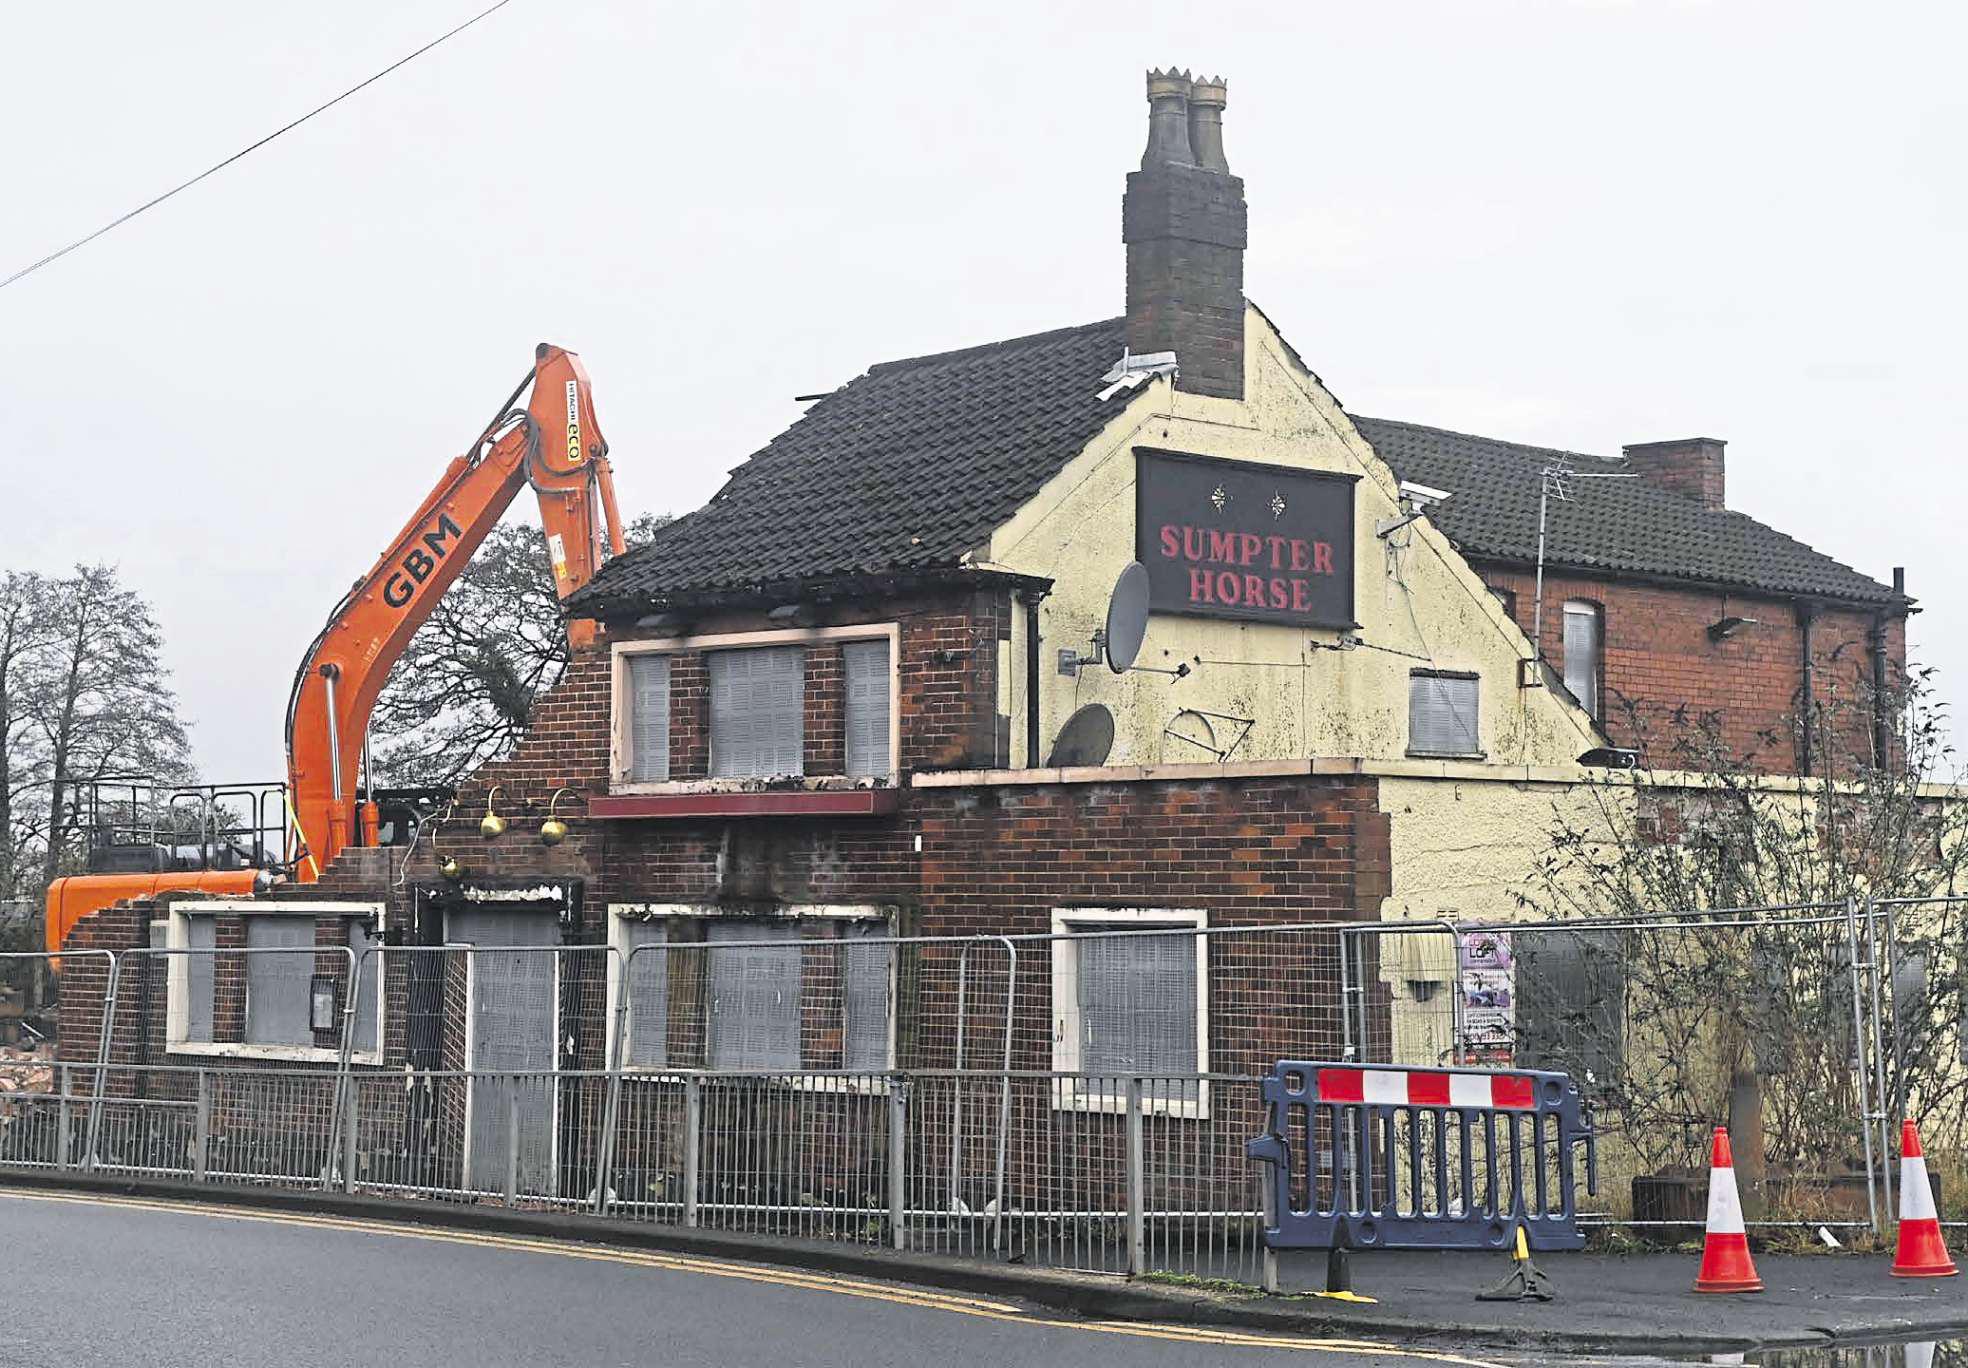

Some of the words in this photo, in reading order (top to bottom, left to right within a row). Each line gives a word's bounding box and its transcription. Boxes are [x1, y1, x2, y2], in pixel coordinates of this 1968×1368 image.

[568, 424, 580, 459] eco
[383, 512, 462, 609] GBM
[1160, 524, 1335, 576] SUMPTER
[1188, 567, 1312, 612] HORSE
